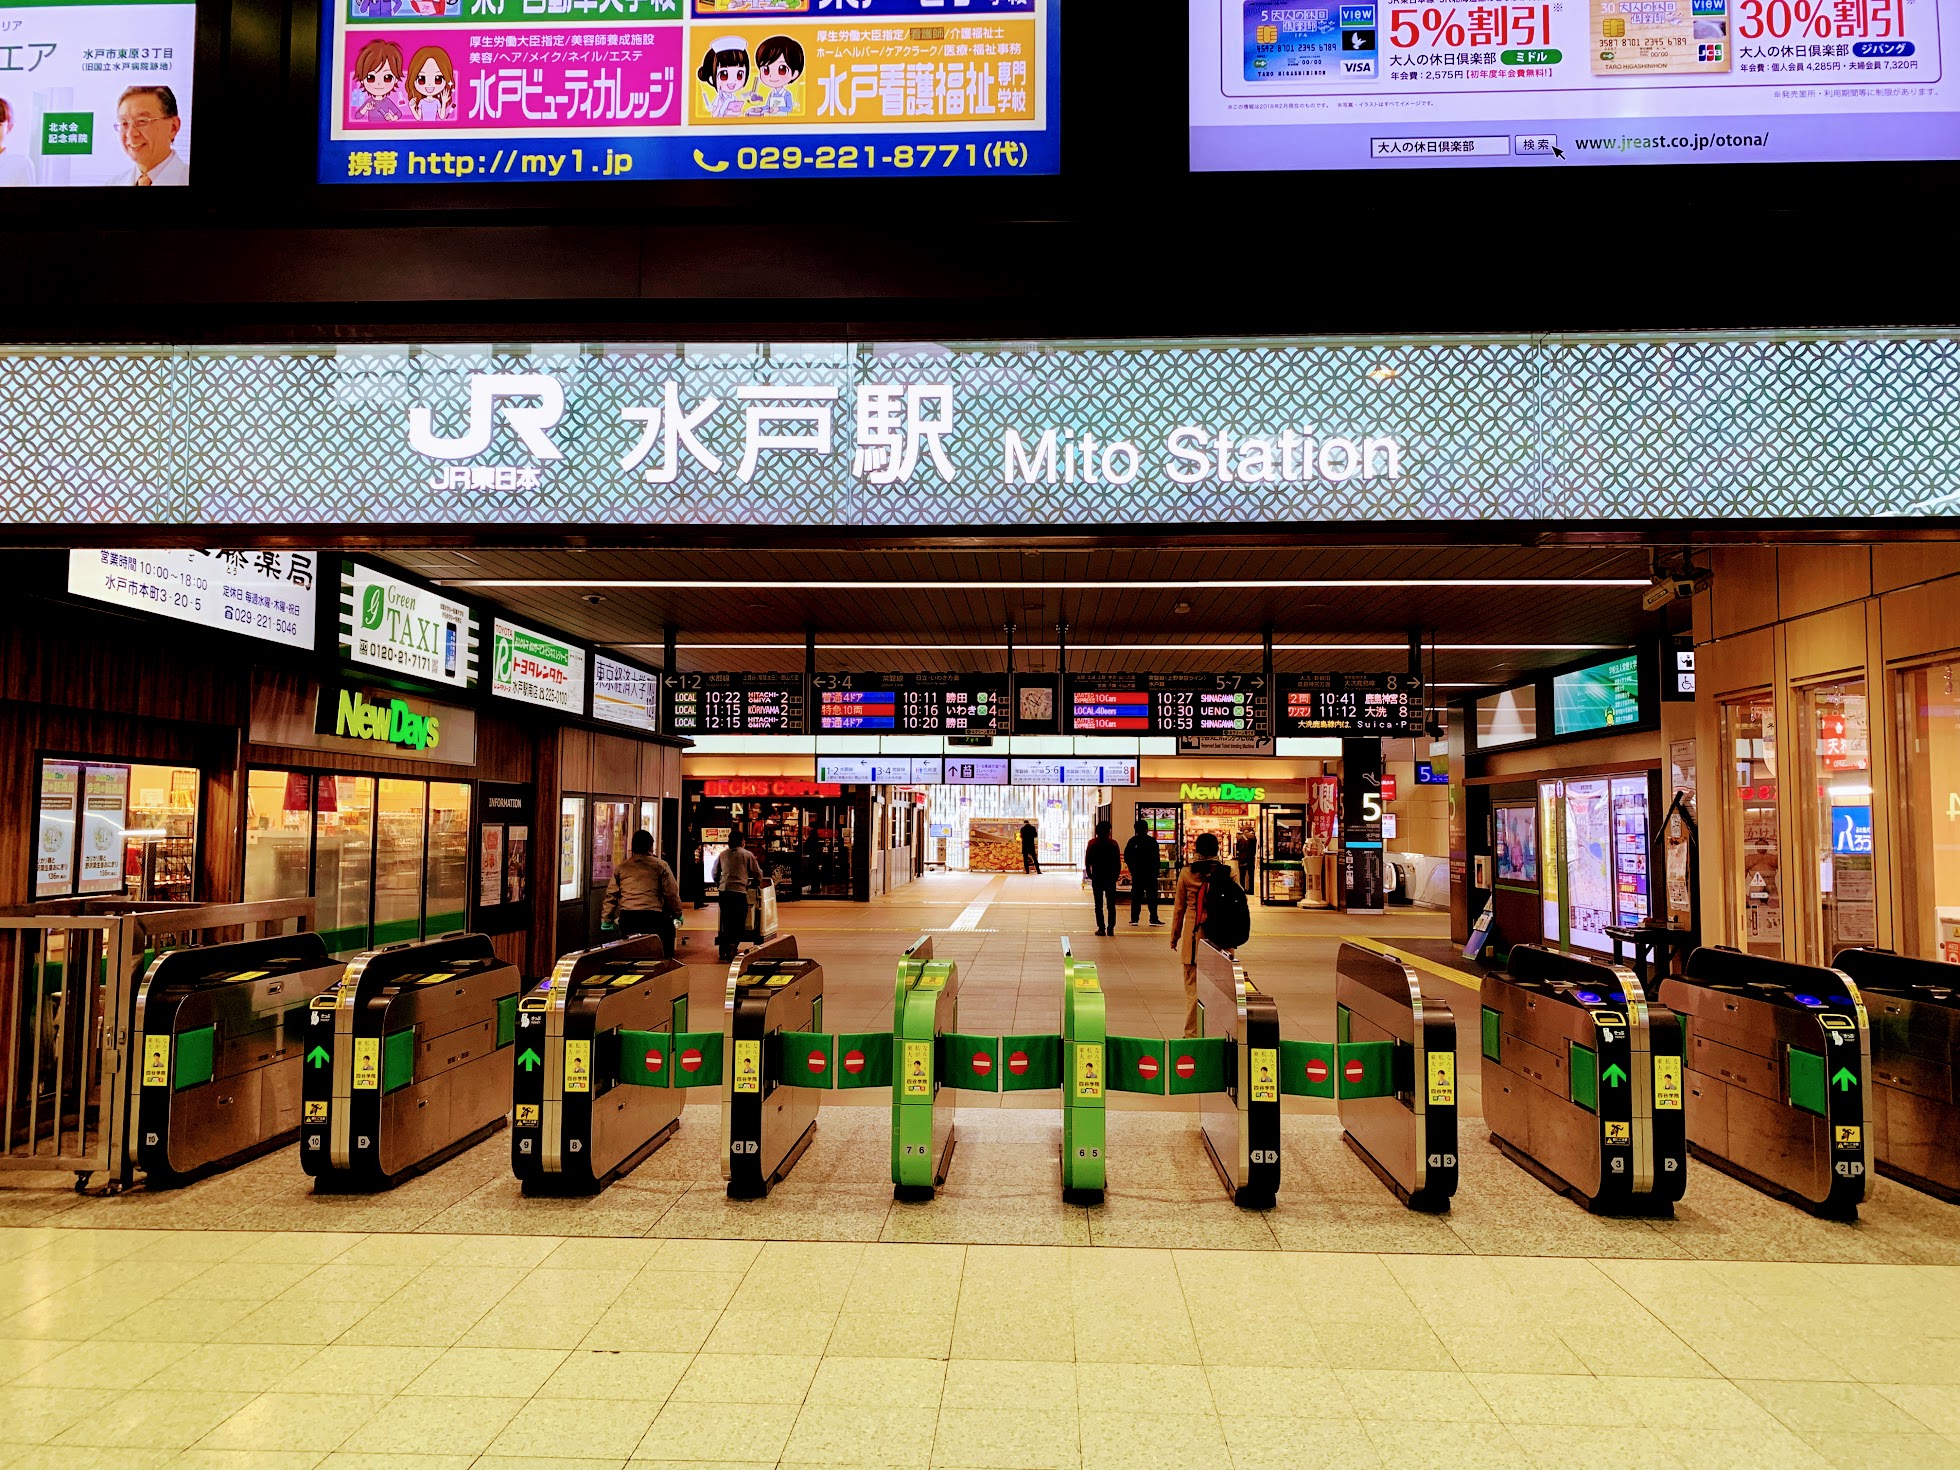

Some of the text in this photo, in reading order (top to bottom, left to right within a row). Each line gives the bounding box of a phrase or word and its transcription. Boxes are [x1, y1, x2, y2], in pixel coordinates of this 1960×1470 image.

[1739, 0, 1905, 39] 30%割引
[1389, 5, 1550, 48] 5%割引
[469, 33, 655, 48] 厚生労働大臣指定/美容師養成施設
[1622, 38, 1640, 47] 8701
[1645, 38, 1664, 46] 2345
[1667, 38, 1687, 46] 6789
[83, 48, 173, 60] 水戸市東原3丁目
[1698, 45, 1723, 62] JCB
[1740, 43, 1906, 58] 大人の休日倶楽部 ジパング
[469, 51, 643, 65] 美容/ヘア/メイク/ネイル/エステ
[1390, 52, 1547, 66] 大人の休日倶楽部 ミドル
[81, 62, 172, 72] (旧国立水戸病院跡地)
[998, 61, 1026, 84] 専門
[1344, 63, 1371, 73] VISA
[469, 67, 675, 121] 水戸ビューティカレッジ
[817, 63, 996, 117] 水戸看護福祉
[998, 90, 1026, 114] 学校
[49, 122, 78, 132] 北水会
[48, 133, 88, 144] 記念病院
[1575, 132, 1770, 153] www.jreast.co.jp/otona/
[1378, 140, 1475, 153] 大人の休日倶楽部
[1523, 139, 1550, 152] 検索
[737, 141, 1028, 170] 029-221-8771(代)
[348, 149, 633, 178] 携帯 http://my1.jp
[409, 373, 567, 462] JR
[620, 380, 1400, 486] 水戸駅 Mito Station
[430, 465, 543, 491] JR東日本
[100, 550, 137, 572] 営業時間
[222, 585, 243, 601] 定休日
[388, 585, 417, 611] Green
[235, 608, 297, 636] 029-221-5046
[387, 608, 440, 655] TAXI
[495, 624, 512, 638] TOYOTA
[513, 656, 568, 685] トヨタレンタカー
[1387, 676, 1396, 690] 8
[675, 692, 697, 702] LOCAL
[705, 692, 741, 703] 10:22
[781, 692, 788, 703] 2
[903, 692, 938, 703] 10:11
[946, 693, 967, 704] 勝田
[989, 692, 997, 703] 4
[1157, 693, 1193, 704] 10:27
[1200, 694, 1234, 704] SHINAGAWA
[1246, 693, 1253, 704] 7
[1290, 693, 1408, 704] 2両 10:41 鹿島神宮 8
[675, 704, 697, 715] LOCAL
[705, 704, 741, 716] 11:15
[781, 704, 788, 716] 2
[821, 704, 997, 716] 特急10両 10:16 いわき 4
[1074, 707, 1095, 716] LOCAL
[1157, 706, 1193, 717] 10:30
[1201, 707, 1229, 716] UENO
[1246, 706, 1253, 717] 5
[1288, 706, 1408, 718] ワンマン 11:12 大洗 8
[336, 689, 439, 750] NewDays
[675, 717, 697, 728] LOCAL
[705, 717, 741, 728] 12:15
[781, 717, 788, 728] 2
[903, 717, 939, 728] 10:20
[946, 717, 967, 728] 勝田
[989, 717, 997, 728] 4
[1157, 718, 1193, 729] 10:53
[1200, 719, 1234, 729] SHINAGAWA
[1246, 718, 1253, 729] 7
[1093, 766, 1098, 775] 7
[1123, 766, 1129, 775] 8
[1420, 767, 1430, 782] 5
[1179, 783, 1265, 802] NewDays
[489, 797, 522, 809] INFORMATION
[1363, 792, 1381, 822] 5
[148, 1135, 156, 1144] 10
[311, 1137, 320, 1147] 10
[360, 1138, 366, 1147] 9
[523, 1141, 530, 1149] 9
[571, 1141, 578, 1150] 8
[735, 1143, 742, 1151] 8
[748, 1143, 754, 1151] 7
[906, 1146, 912, 1154] 7
[919, 1146, 925, 1155] 6
[1079, 1149, 1086, 1157] 6
[1092, 1149, 1098, 1157] 5
[1255, 1152, 1260, 1161] 5
[1267, 1152, 1273, 1161] 4
[1432, 1156, 1438, 1164] 4
[1446, 1156, 1452, 1164] 3
[1615, 1160, 1621, 1168] 3
[1667, 1160, 1673, 1169] 2
[1840, 1164, 1846, 1173] 2
[1855, 1165, 1860, 1173] 1
